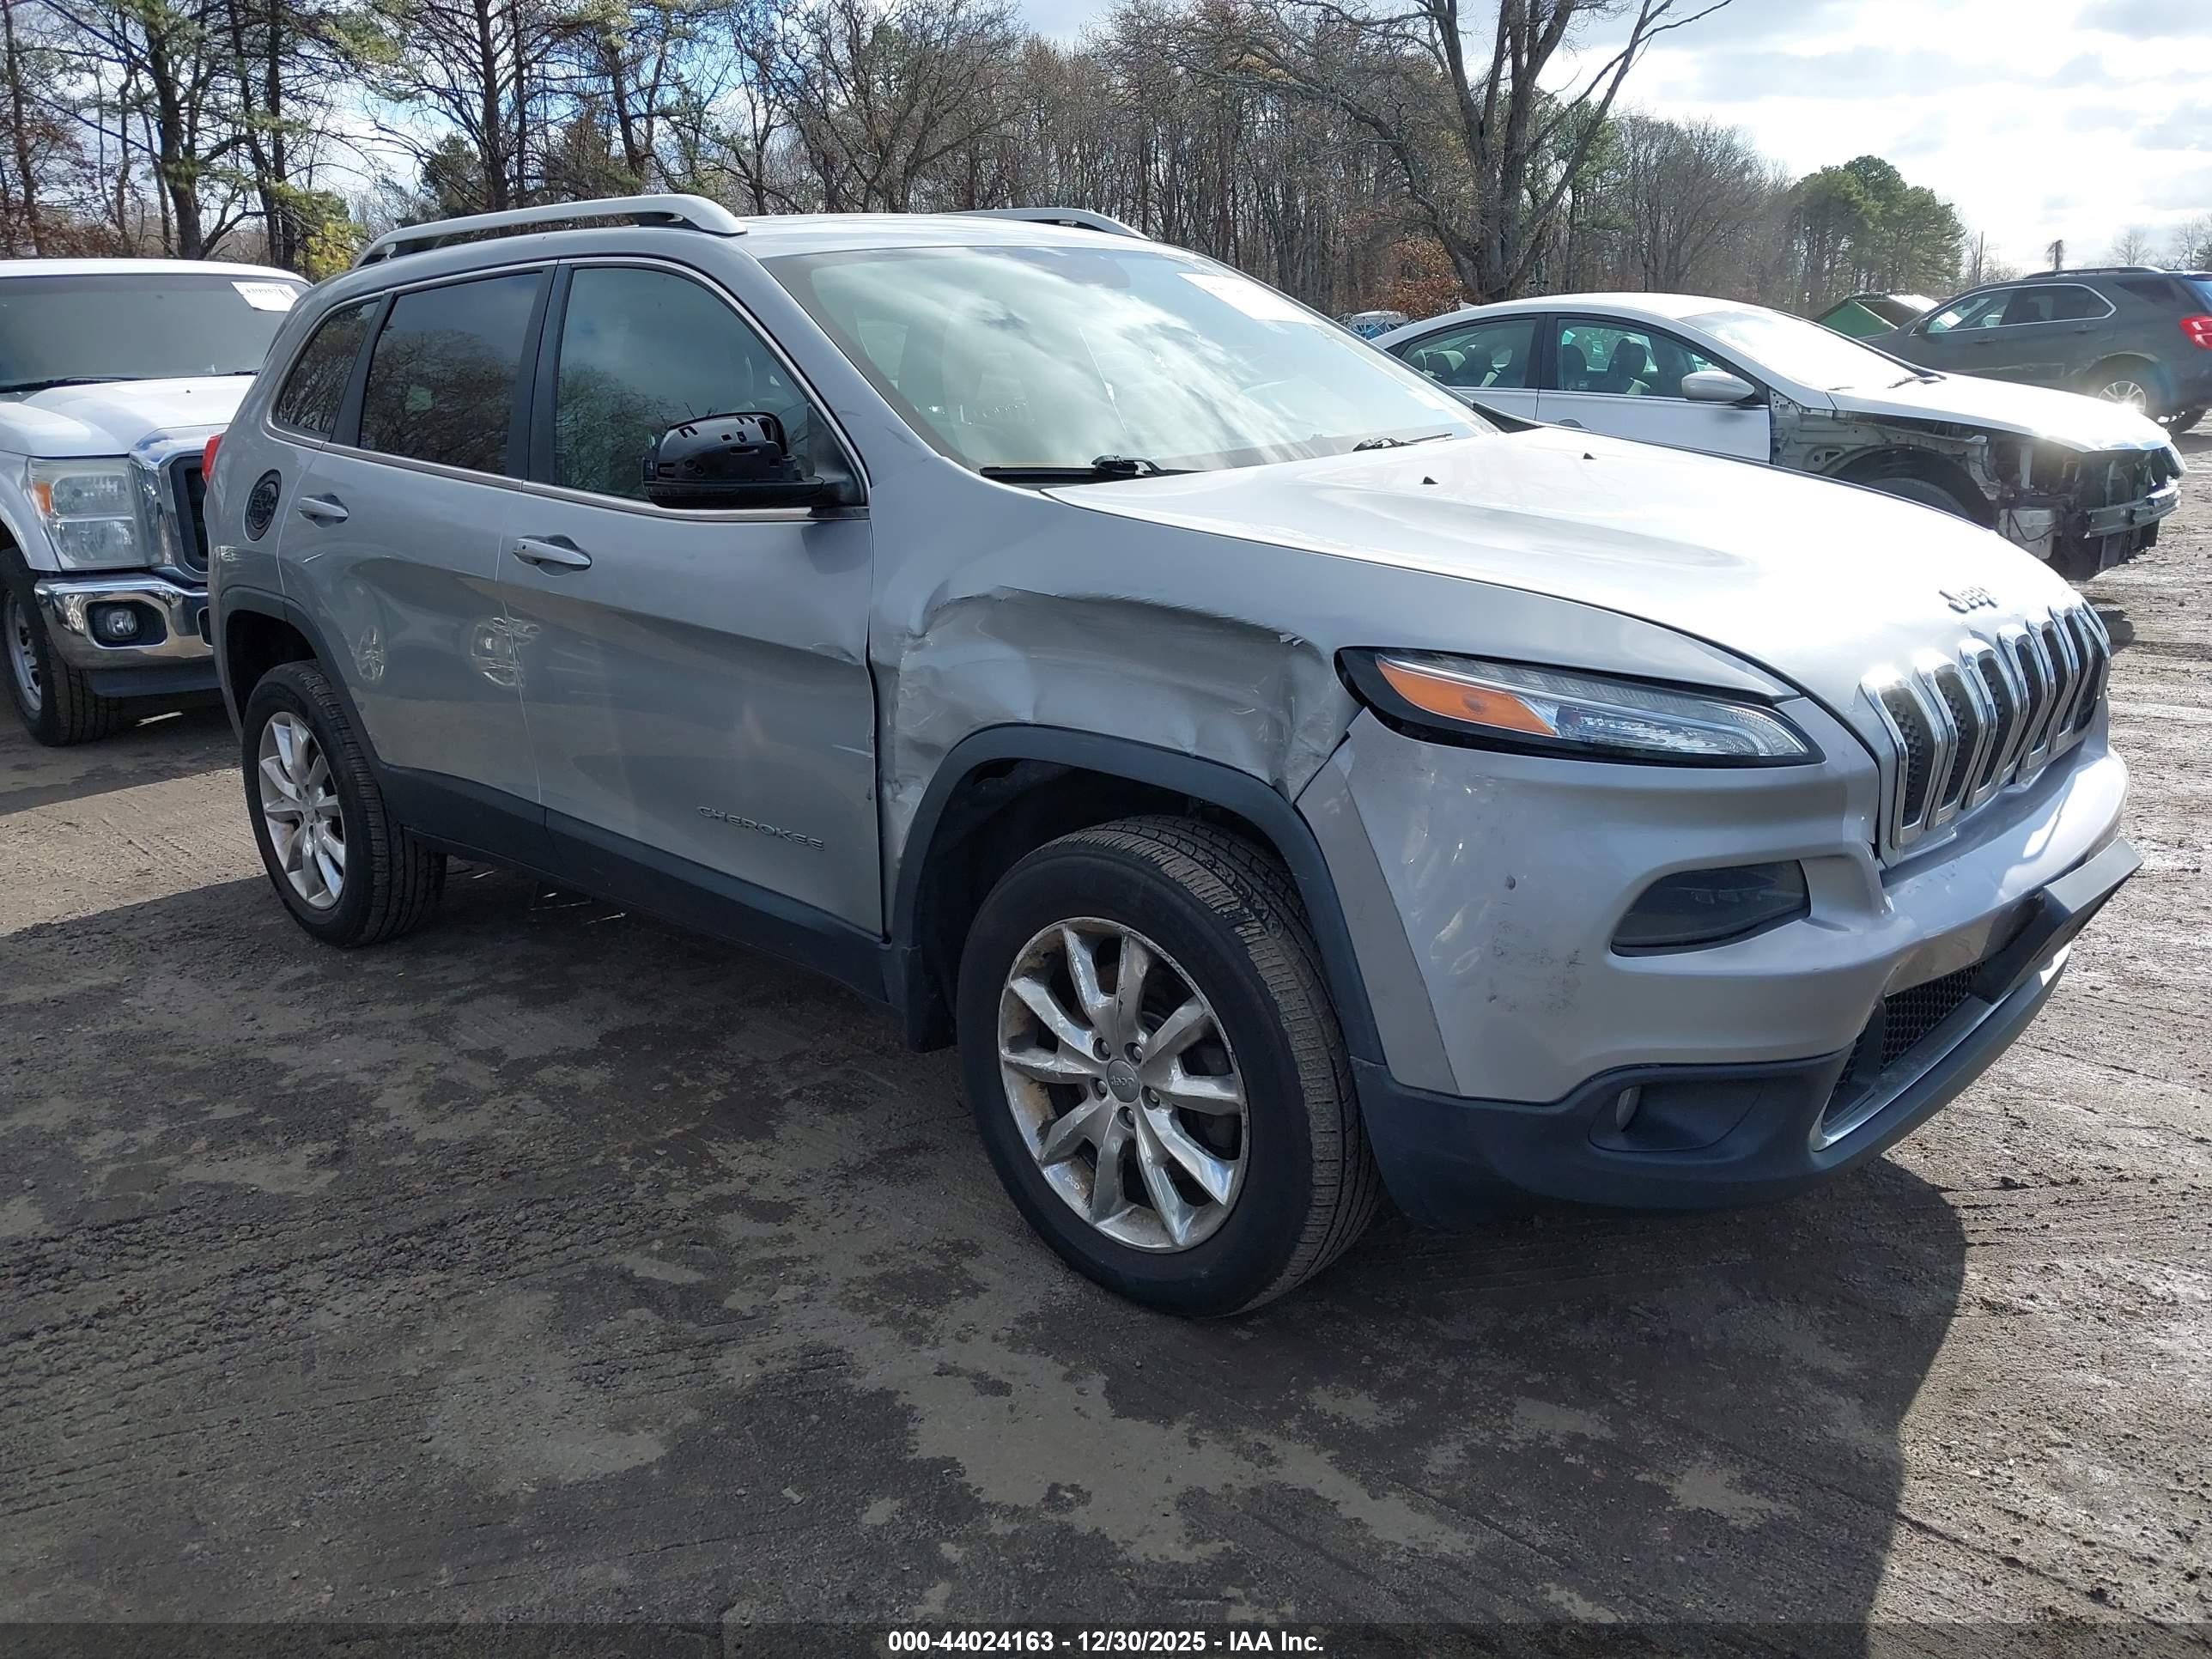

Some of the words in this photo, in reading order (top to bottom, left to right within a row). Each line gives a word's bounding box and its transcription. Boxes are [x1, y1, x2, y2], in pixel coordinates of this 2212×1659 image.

[1939, 586, 1999, 614] Jeep
[696, 805, 825, 851] CHEROKEE
[1110, 1074, 1134, 1088] Jeep
